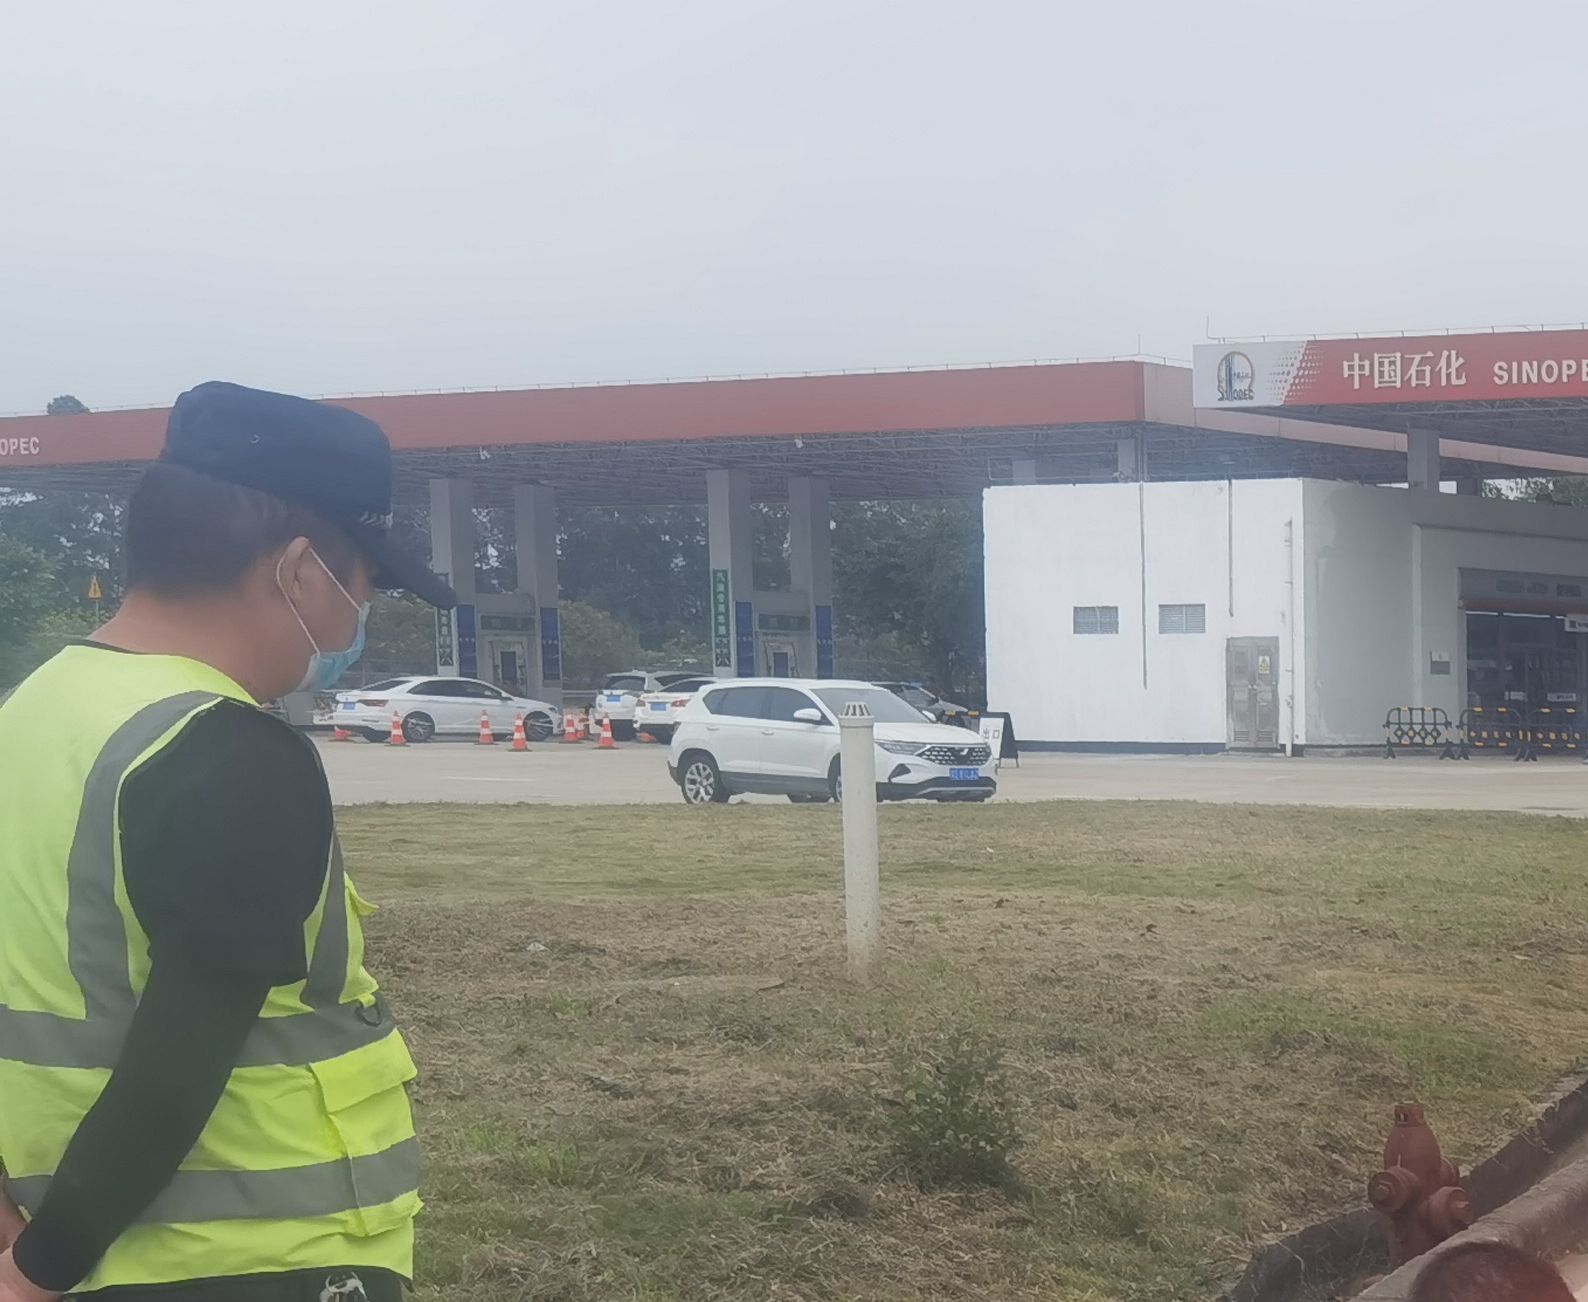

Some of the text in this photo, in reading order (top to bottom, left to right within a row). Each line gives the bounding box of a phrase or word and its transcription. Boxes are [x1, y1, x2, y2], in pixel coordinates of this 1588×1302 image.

[1342, 349, 1466, 390] 中国石化
[0, 437, 40, 455] OPEC
[983, 728, 1000, 739] 出口
